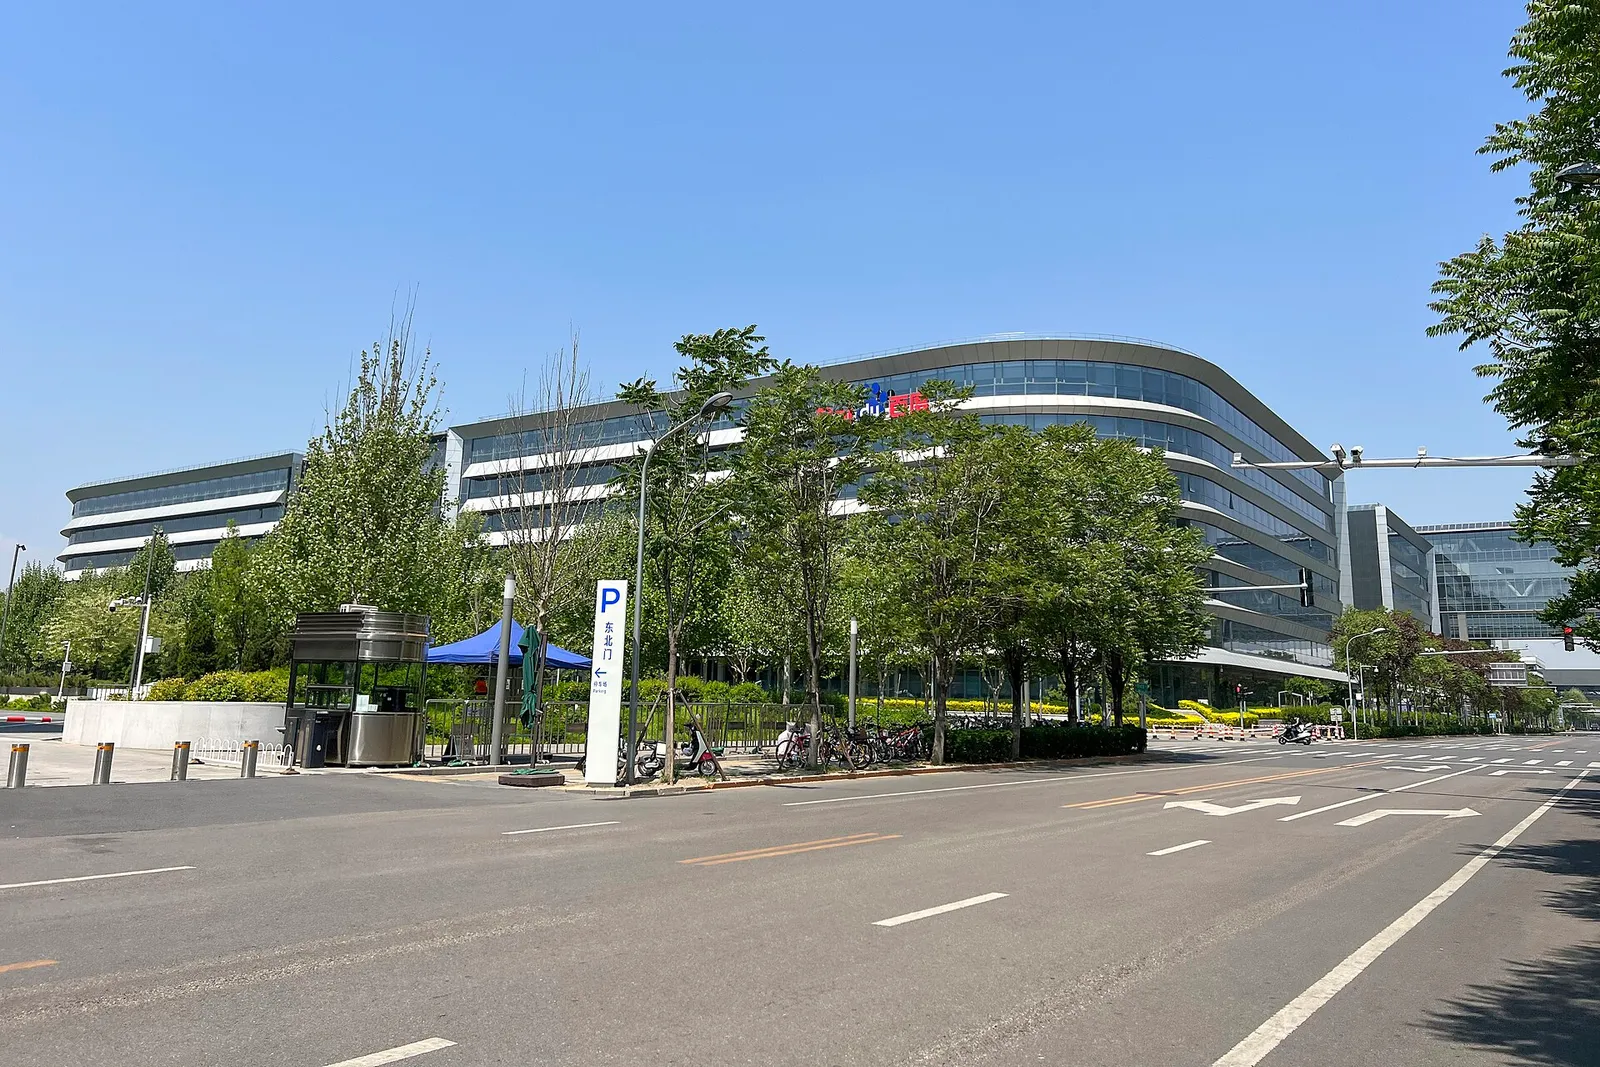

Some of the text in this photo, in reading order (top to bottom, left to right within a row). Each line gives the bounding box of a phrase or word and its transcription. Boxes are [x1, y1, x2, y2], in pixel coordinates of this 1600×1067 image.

[601, 588, 620, 613] P
[603, 622, 614, 660] 东北门
